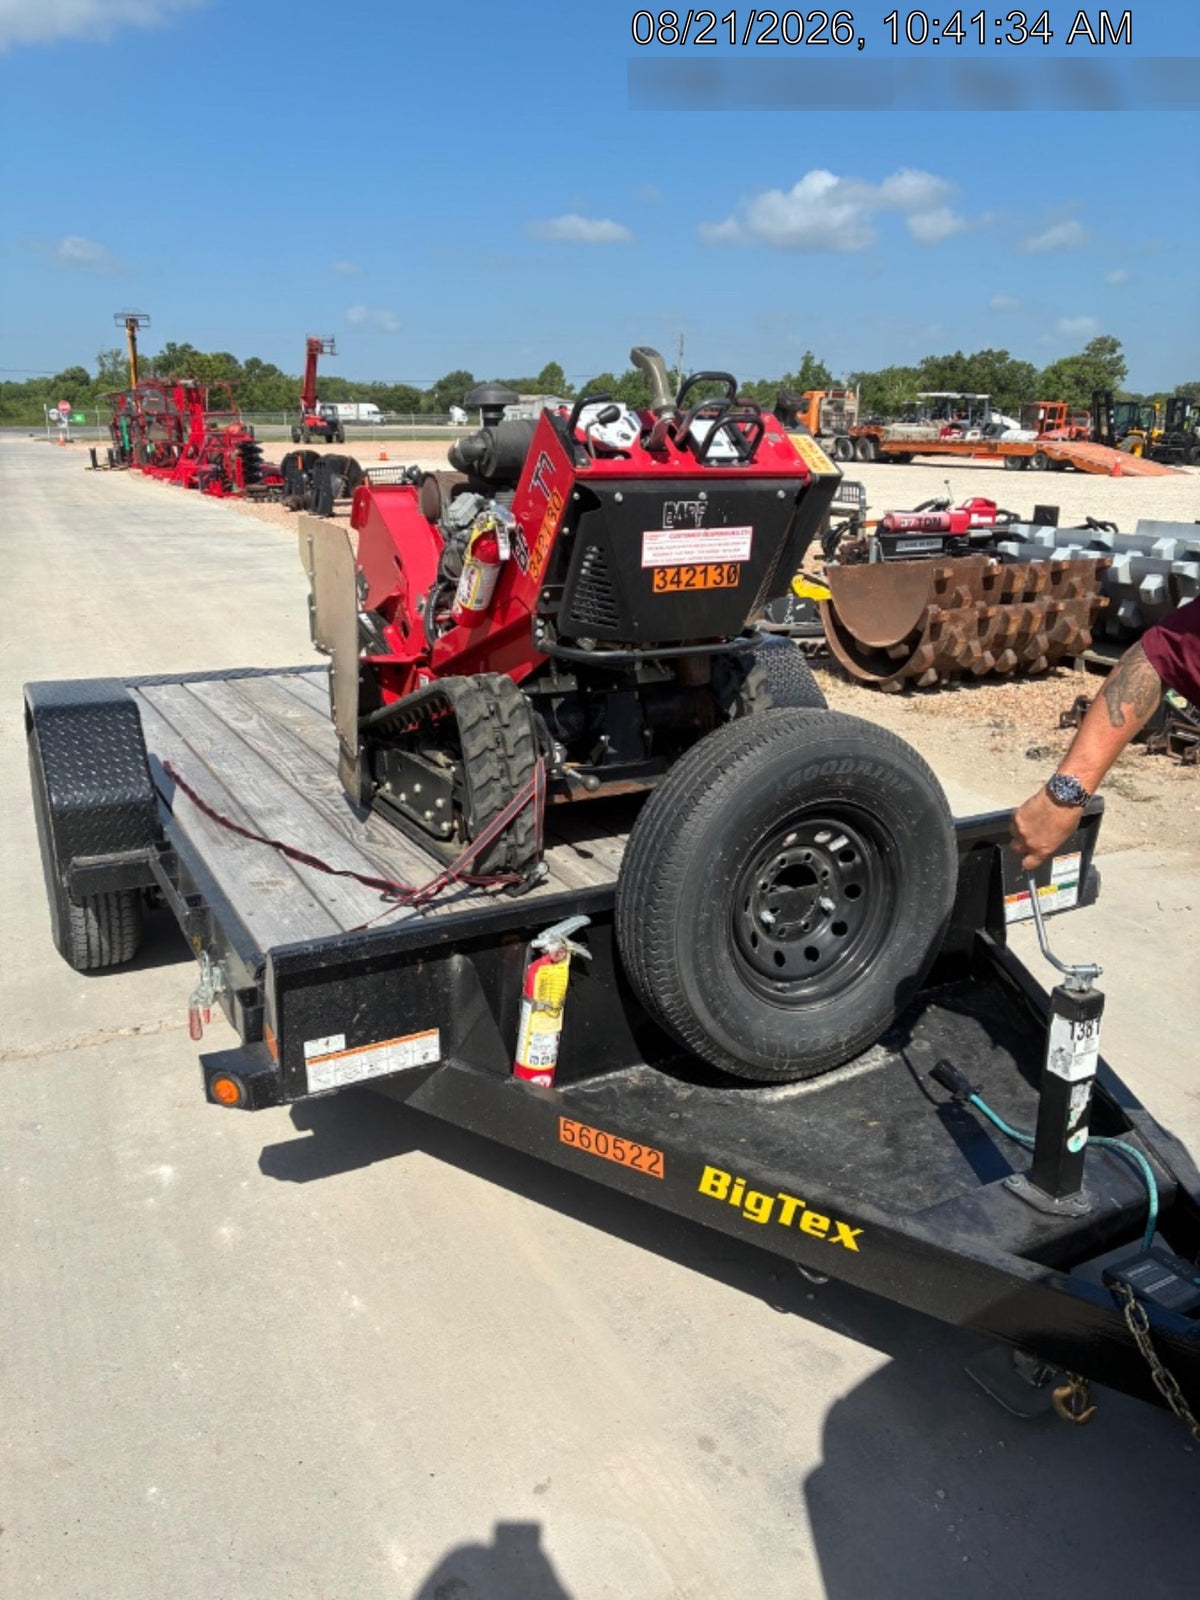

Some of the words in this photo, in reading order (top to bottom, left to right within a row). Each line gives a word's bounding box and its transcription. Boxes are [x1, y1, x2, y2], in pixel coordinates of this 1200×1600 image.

[529, 491, 563, 579] 342130
[655, 564, 738, 590] 342130
[560, 1119, 662, 1175] 560522
[697, 1165, 865, 1253] BigTex
